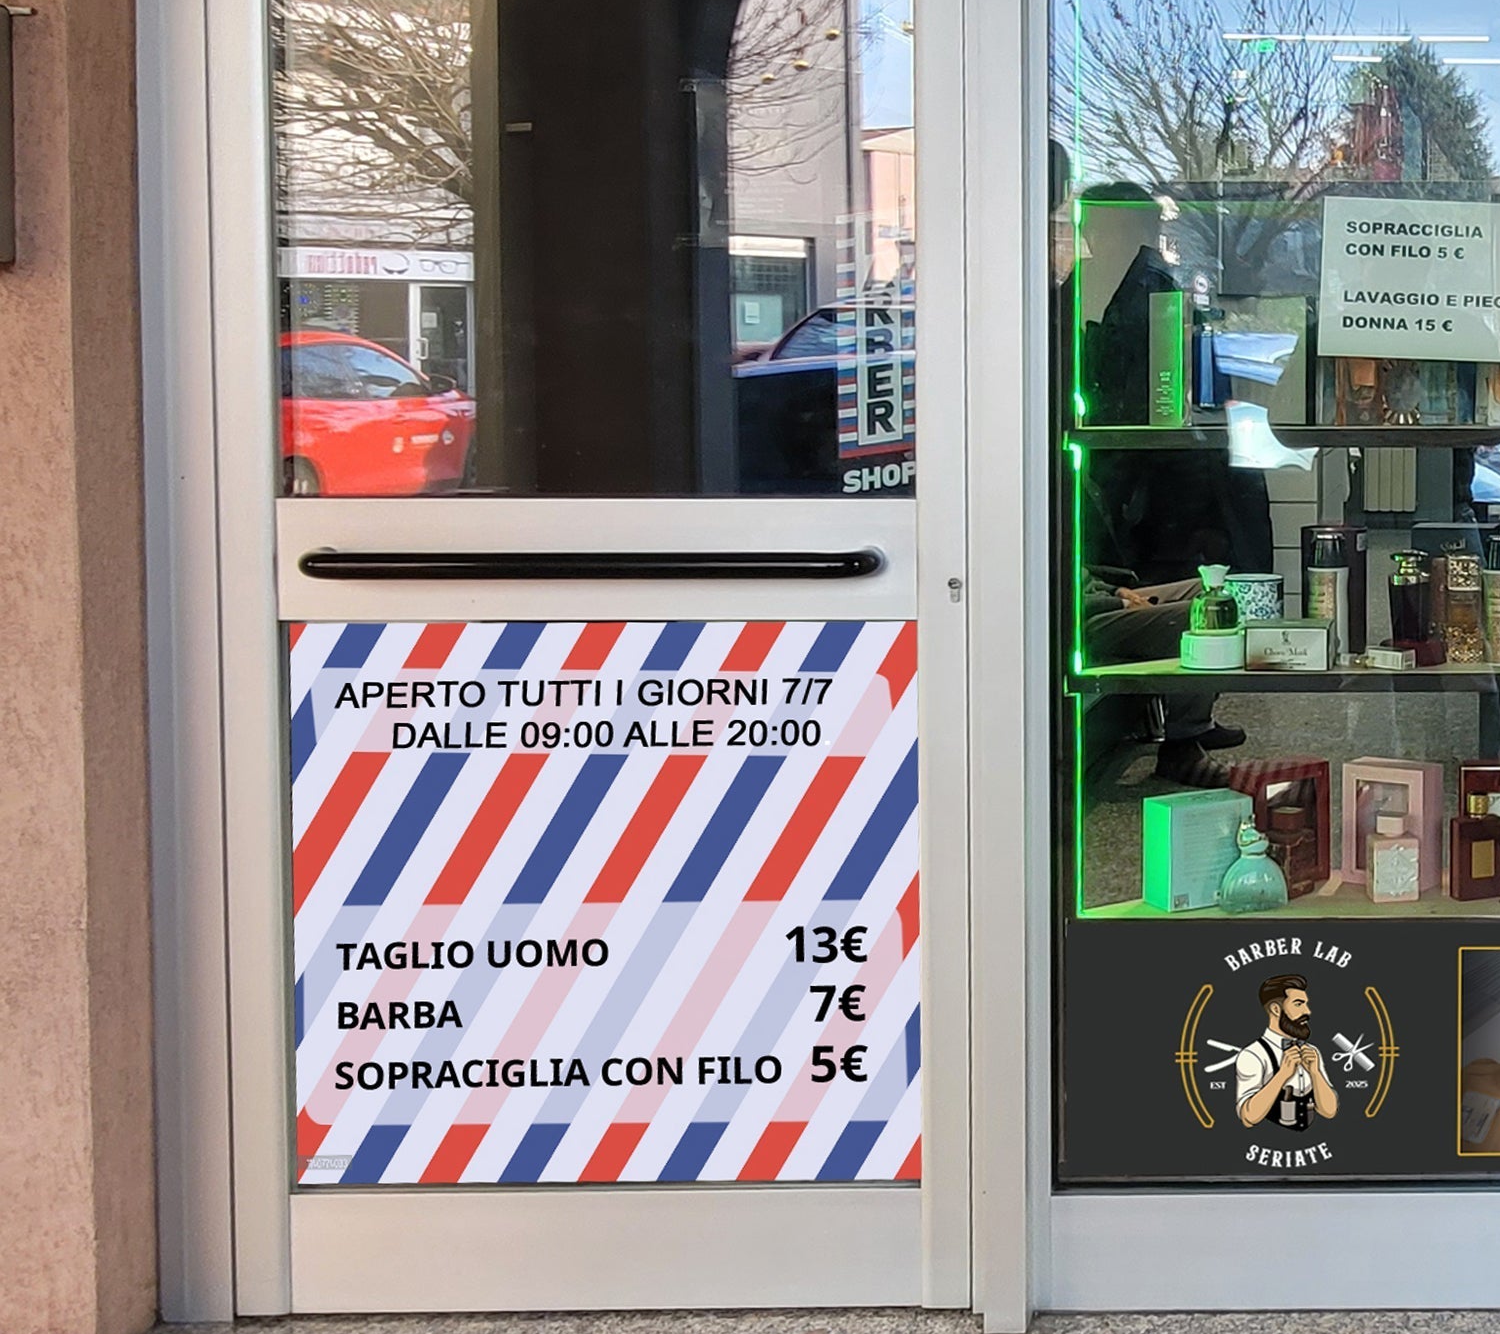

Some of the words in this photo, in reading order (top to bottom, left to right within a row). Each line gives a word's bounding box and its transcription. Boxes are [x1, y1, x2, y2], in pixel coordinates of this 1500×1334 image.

[1346, 221, 1484, 239] SOPRACCIGLIA
[1345, 243, 1385, 257] CON
[1391, 244, 1431, 259] FILO
[1437, 246, 1448, 259] 5
[1453, 247, 1465, 259] €
[1344, 290, 1440, 306] LAVAGGIO
[1446, 294, 1457, 307] E
[1342, 316, 1409, 331] DONNA
[1415, 319, 1436, 332] 15
[1442, 319, 1453, 332] €
[334, 680, 486, 709] APERTO
[498, 679, 602, 708] TUTTI
[616, 679, 624, 706] I
[637, 678, 768, 707] GIORNI
[781, 677, 834, 706] 7/7
[391, 721, 508, 749] DALLE
[520, 721, 614, 749] 09:00
[623, 720, 715, 748] ALLE
[727, 719, 822, 747] 20:00
[336, 940, 475, 971] TAGLIO
[486, 938, 610, 968] UOMO
[785, 924, 869, 964] 13€
[1224, 937, 1303, 972] BARBER
[1313, 941, 1353, 969] LAB
[336, 1000, 463, 1030] BARBA
[808, 983, 867, 1023] 7€
[334, 1058, 590, 1091] SOPRACIGLIA
[600, 1056, 684, 1086] CON
[697, 1054, 783, 1085] FILO
[809, 1044, 869, 1083] 5€
[1245, 1142, 1333, 1167] SERIATE
